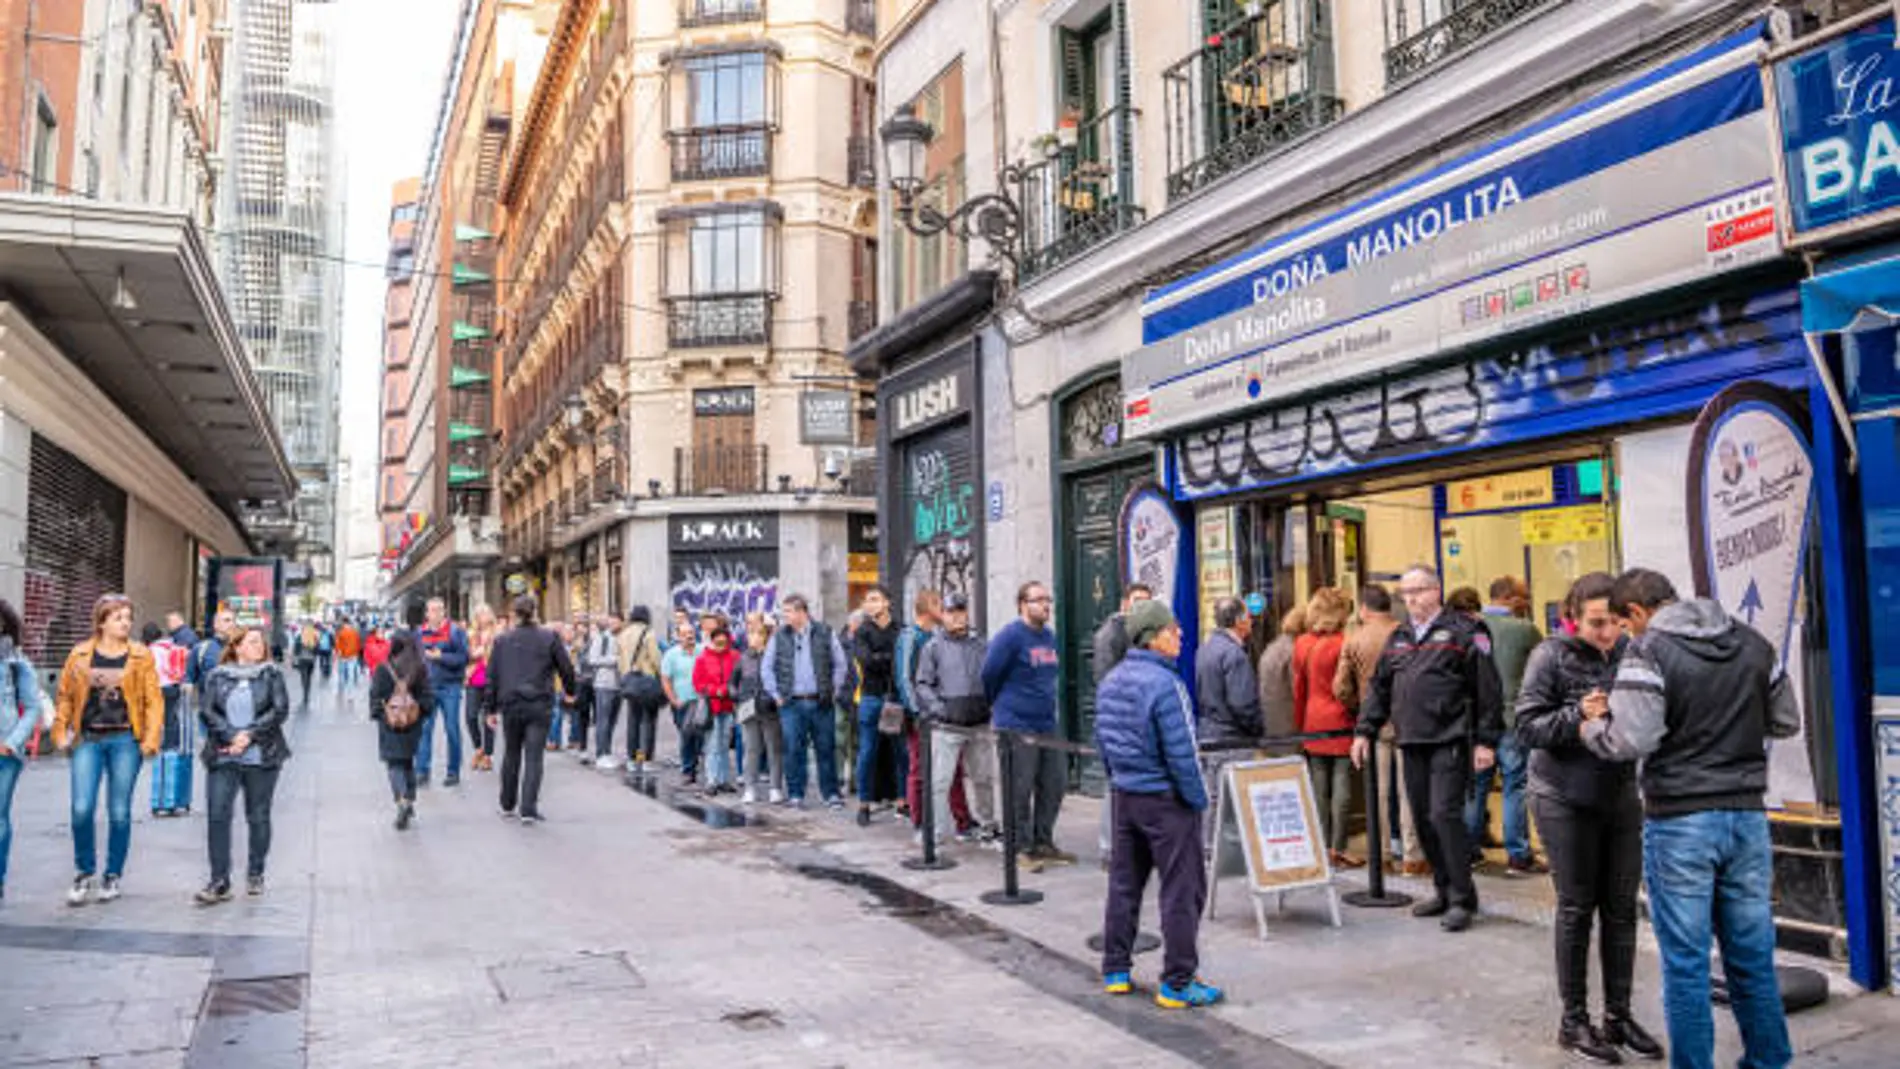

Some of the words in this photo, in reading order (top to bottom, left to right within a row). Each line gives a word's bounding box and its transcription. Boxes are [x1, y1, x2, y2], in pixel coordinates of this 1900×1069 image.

[1824, 52, 1900, 126] La
[1252, 253, 1329, 304] DOÑA
[1346, 176, 1522, 270] MANOLITA
[1235, 296, 1327, 346] Manolita
[898, 375, 958, 431] LUSH
